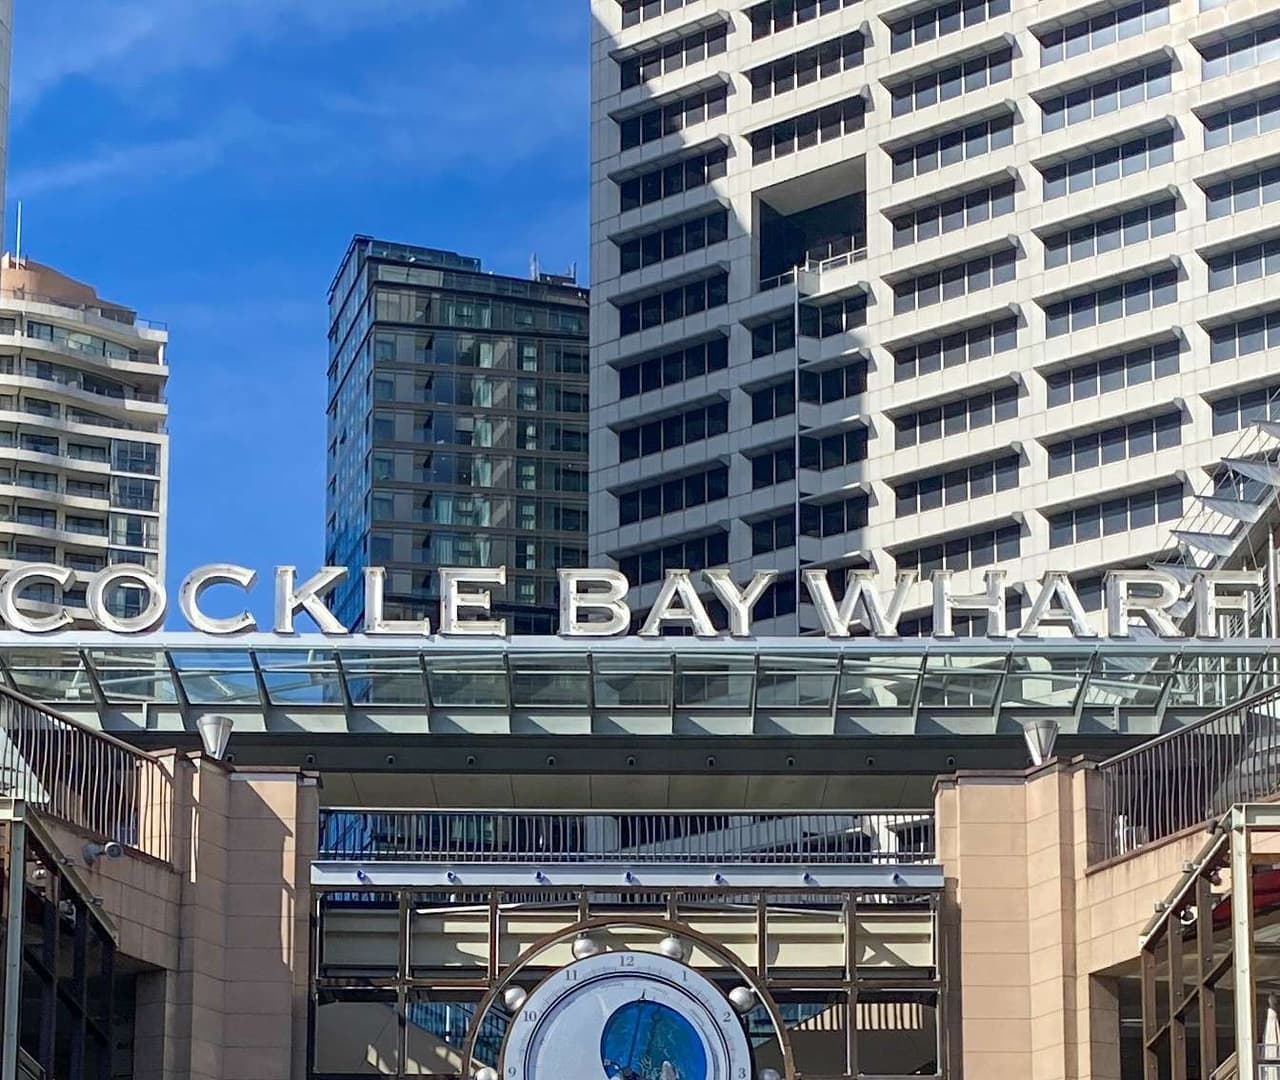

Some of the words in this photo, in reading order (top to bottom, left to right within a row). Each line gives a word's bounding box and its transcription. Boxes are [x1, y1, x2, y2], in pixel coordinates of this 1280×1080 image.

[557, 568, 779, 637] BAY
[801, 568, 1266, 639] WHARF
[619, 955, 634, 967] 12
[566, 969, 577, 981] 11
[523, 1010, 537, 1022] 10
[723, 1011, 731, 1022] 2
[508, 1066, 517, 1077] 9
[738, 1067, 746, 1079] 3
